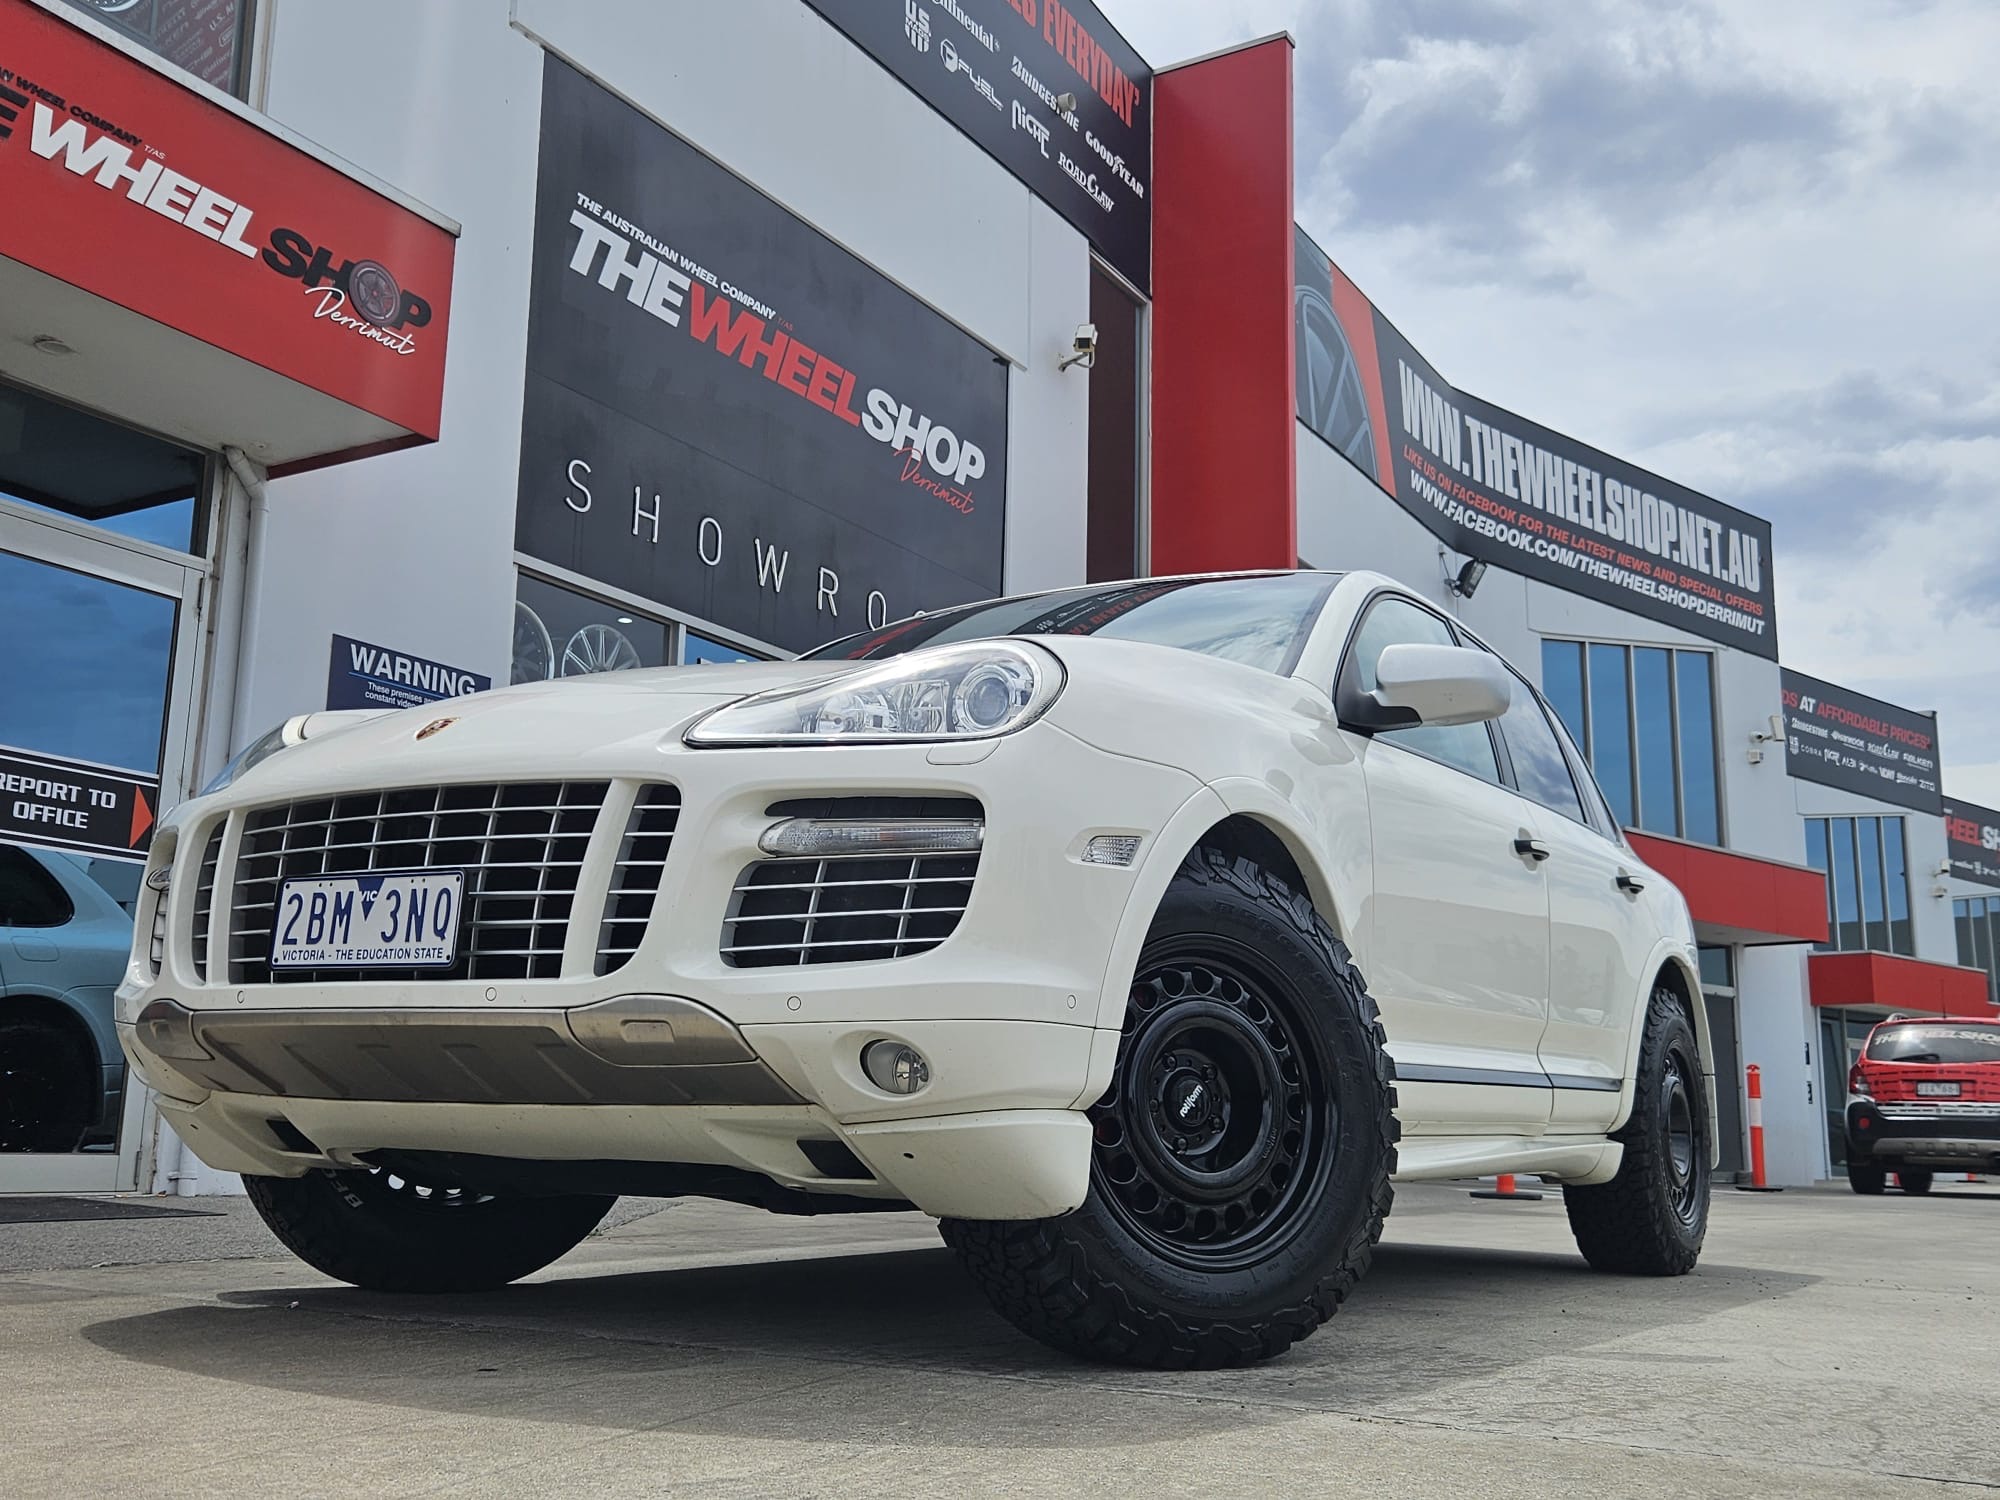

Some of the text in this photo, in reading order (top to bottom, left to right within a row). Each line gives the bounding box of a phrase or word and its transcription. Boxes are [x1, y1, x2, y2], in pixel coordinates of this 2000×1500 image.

[958, 58, 1004, 108] FUEL
[69, 105, 143, 147] COMPANY
[144, 144, 168, 160] T/AS
[31, 101, 258, 259] WHEEL
[1085, 130, 1144, 199] GOODYEAR
[577, 191, 603, 216] THE
[602, 207, 679, 264] AUSTRALIAN
[680, 255, 719, 289] WHEEL
[720, 281, 777, 321] COMPANY
[304, 286, 416, 356] Derrimut
[569, 209, 986, 486] THE WHEEL SHOP
[893, 446, 975, 514] Derrimut
[565, 459, 927, 633] SHOWRO
[1403, 444, 1763, 616] LIKE US ON FACEBOOK FOR THE LATEST NEWS AND SPECIAL OFFERS
[350, 643, 476, 697] WARNING
[365, 691, 396, 705] constant
[368, 681, 391, 695] These
[390, 688, 423, 704] premises
[1799, 695, 1816, 714] AT
[1816, 701, 1889, 737] AFFORDABLE
[0, 771, 117, 809] REPORT TO
[12, 800, 89, 829] OFFICE
[281, 887, 452, 946] 2BM 3NQ
[282, 949, 325, 961] VICTORIA
[335, 949, 354, 960] THE
[356, 948, 411, 960] EDUCATION
[414, 947, 443, 959] STATE
